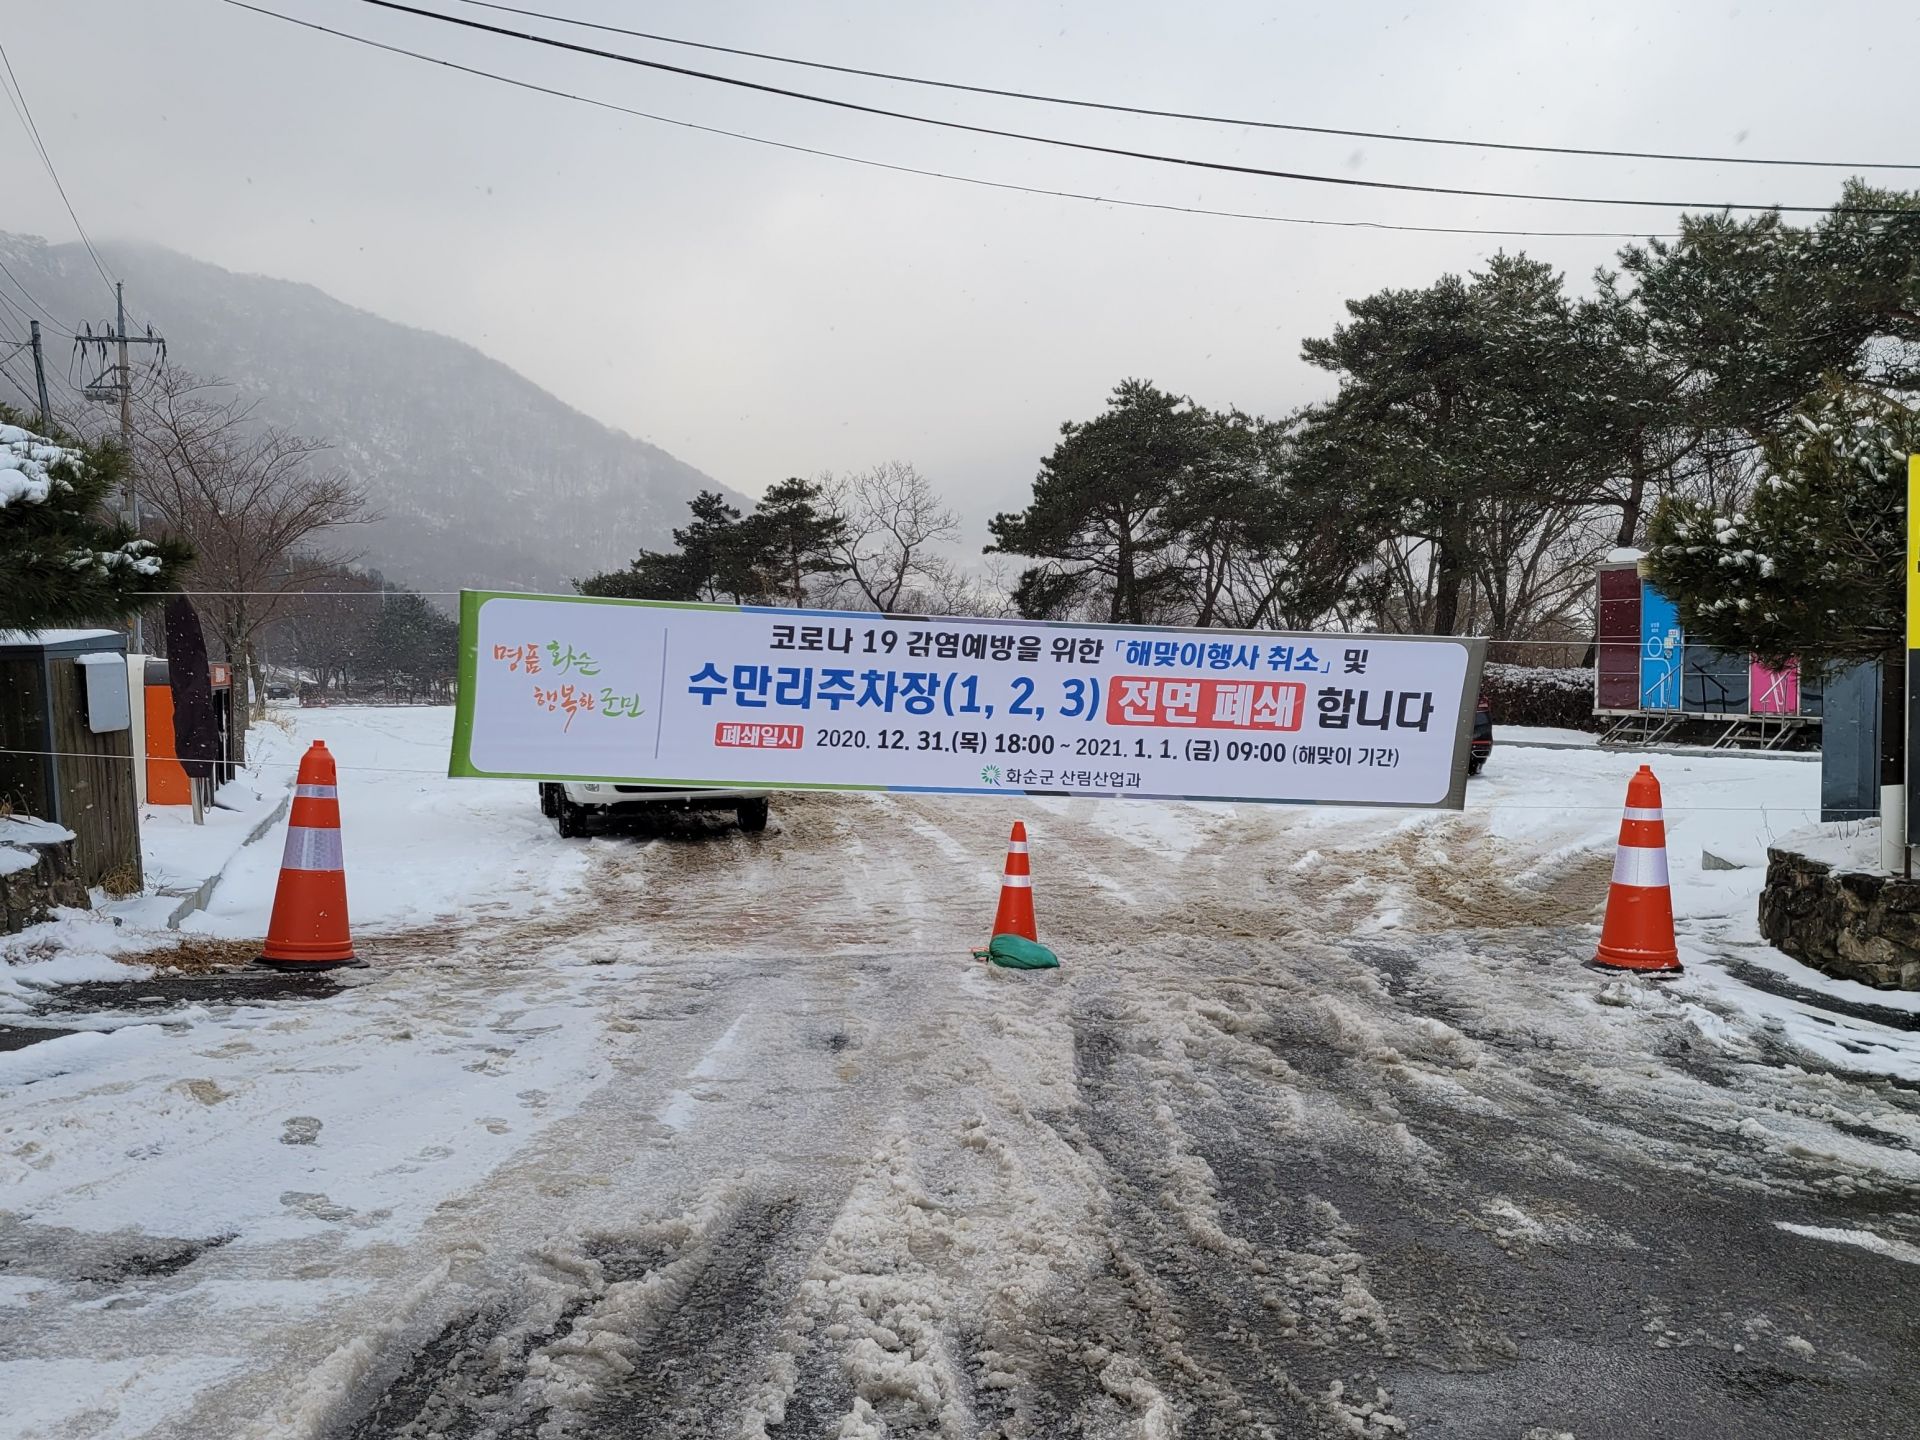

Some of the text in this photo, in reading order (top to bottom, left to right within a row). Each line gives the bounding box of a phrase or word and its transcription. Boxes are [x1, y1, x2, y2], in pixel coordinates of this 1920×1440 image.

[493, 640, 601, 676] 명품 화순
[770, 624, 854, 654] 코로나
[862, 629, 898, 654] 19
[906, 630, 1042, 662] 감염예방을
[1050, 636, 1104, 664] 위한
[1343, 648, 1369, 675] 및
[533, 684, 645, 734] 행복한 군민
[1008, 676, 1045, 722] 2,
[1059, 677, 1100, 722] 3)
[1118, 680, 1201, 724] 전면
[1211, 684, 1297, 728] 폐쇄
[1317, 686, 1435, 733] 합니다
[720, 724, 799, 748] 폐쇄일시
[816, 729, 870, 749] 2020.
[877, 729, 910, 751] 12.
[994, 733, 1055, 755] 18:00
[1075, 738, 1127, 758] 2021.
[1134, 738, 1152, 760] 1.
[1160, 739, 1178, 760] 1.
[1185, 739, 1220, 763] (금)
[1226, 741, 1286, 763] 09:00
[1292, 744, 1351, 766] (해맞이
[1357, 747, 1400, 768] 기간)
[1005, 767, 1141, 788] 화순군 산림산업과
